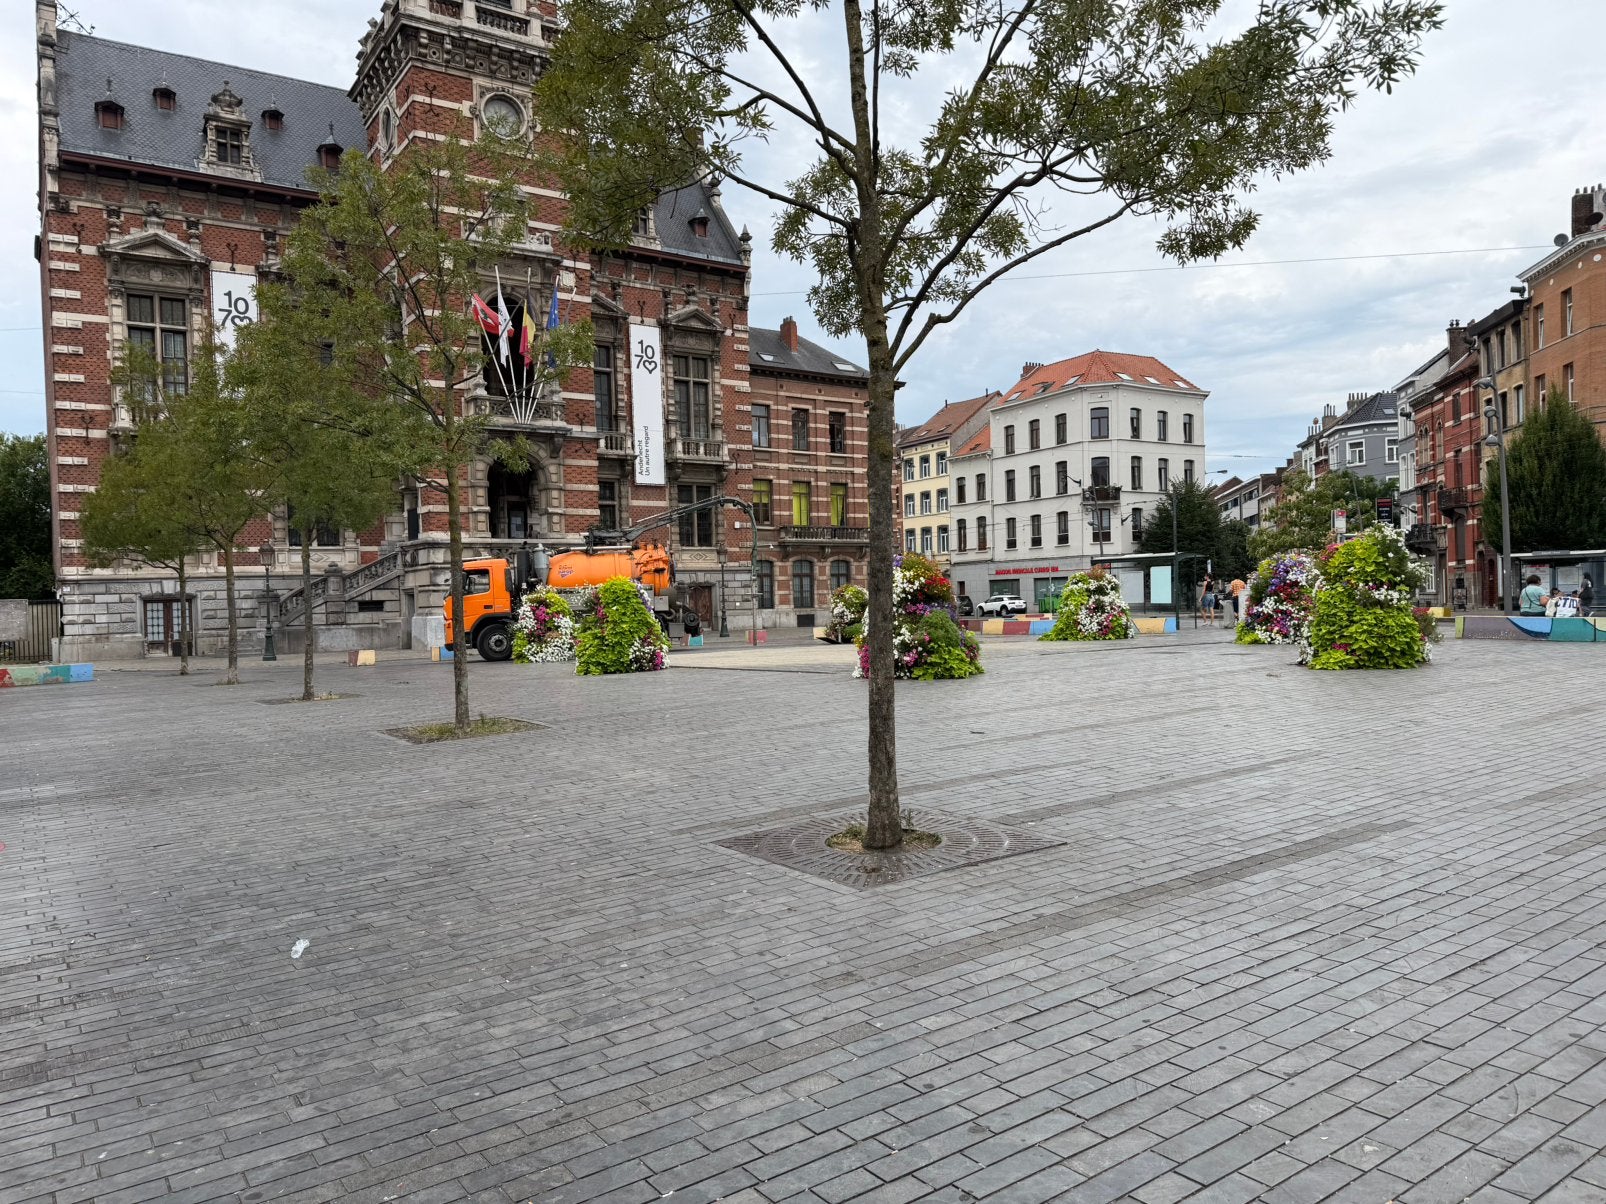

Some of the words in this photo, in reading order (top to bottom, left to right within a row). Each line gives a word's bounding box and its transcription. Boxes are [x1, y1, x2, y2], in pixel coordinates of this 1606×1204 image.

[223, 290, 249, 315] 10
[637, 339, 656, 360] 10
[645, 467, 650, 476] Un
